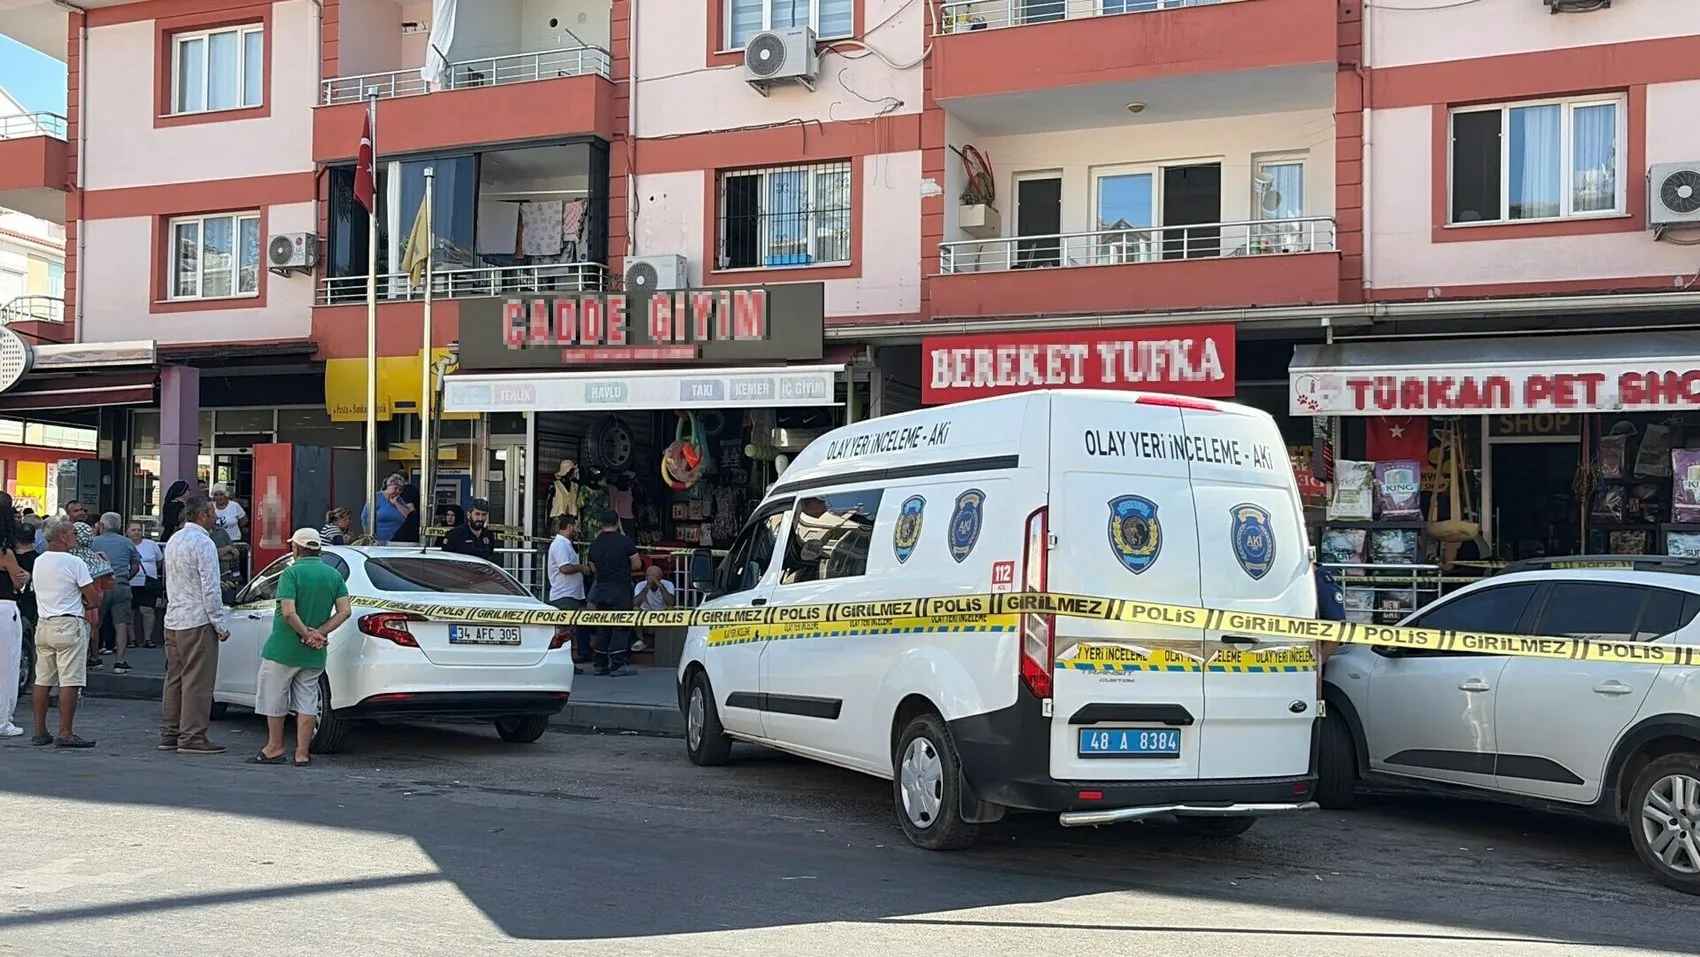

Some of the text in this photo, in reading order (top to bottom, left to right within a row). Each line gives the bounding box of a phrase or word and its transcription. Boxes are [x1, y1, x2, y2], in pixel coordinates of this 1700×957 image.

[930, 344, 1089, 389] BEREKET
[591, 386, 622, 399] HAVLU
[691, 384, 713, 397] TAKI
[735, 382, 770, 396] KEMER
[1523, 372, 1606, 409] PET
[827, 438, 851, 460] OLAY
[1085, 430, 1126, 457] OLAY
[1130, 432, 1166, 459] YERİ
[1253, 444, 1274, 470] AKİ
[1385, 483, 1414, 492] KING
[995, 564, 1011, 582] 112
[458, 627, 518, 640] 34 AFC 305
[1105, 647, 1148, 661] İNCELEM
[1213, 650, 1242, 662] ELEME
[1090, 731, 1177, 750] 48 A 8384
